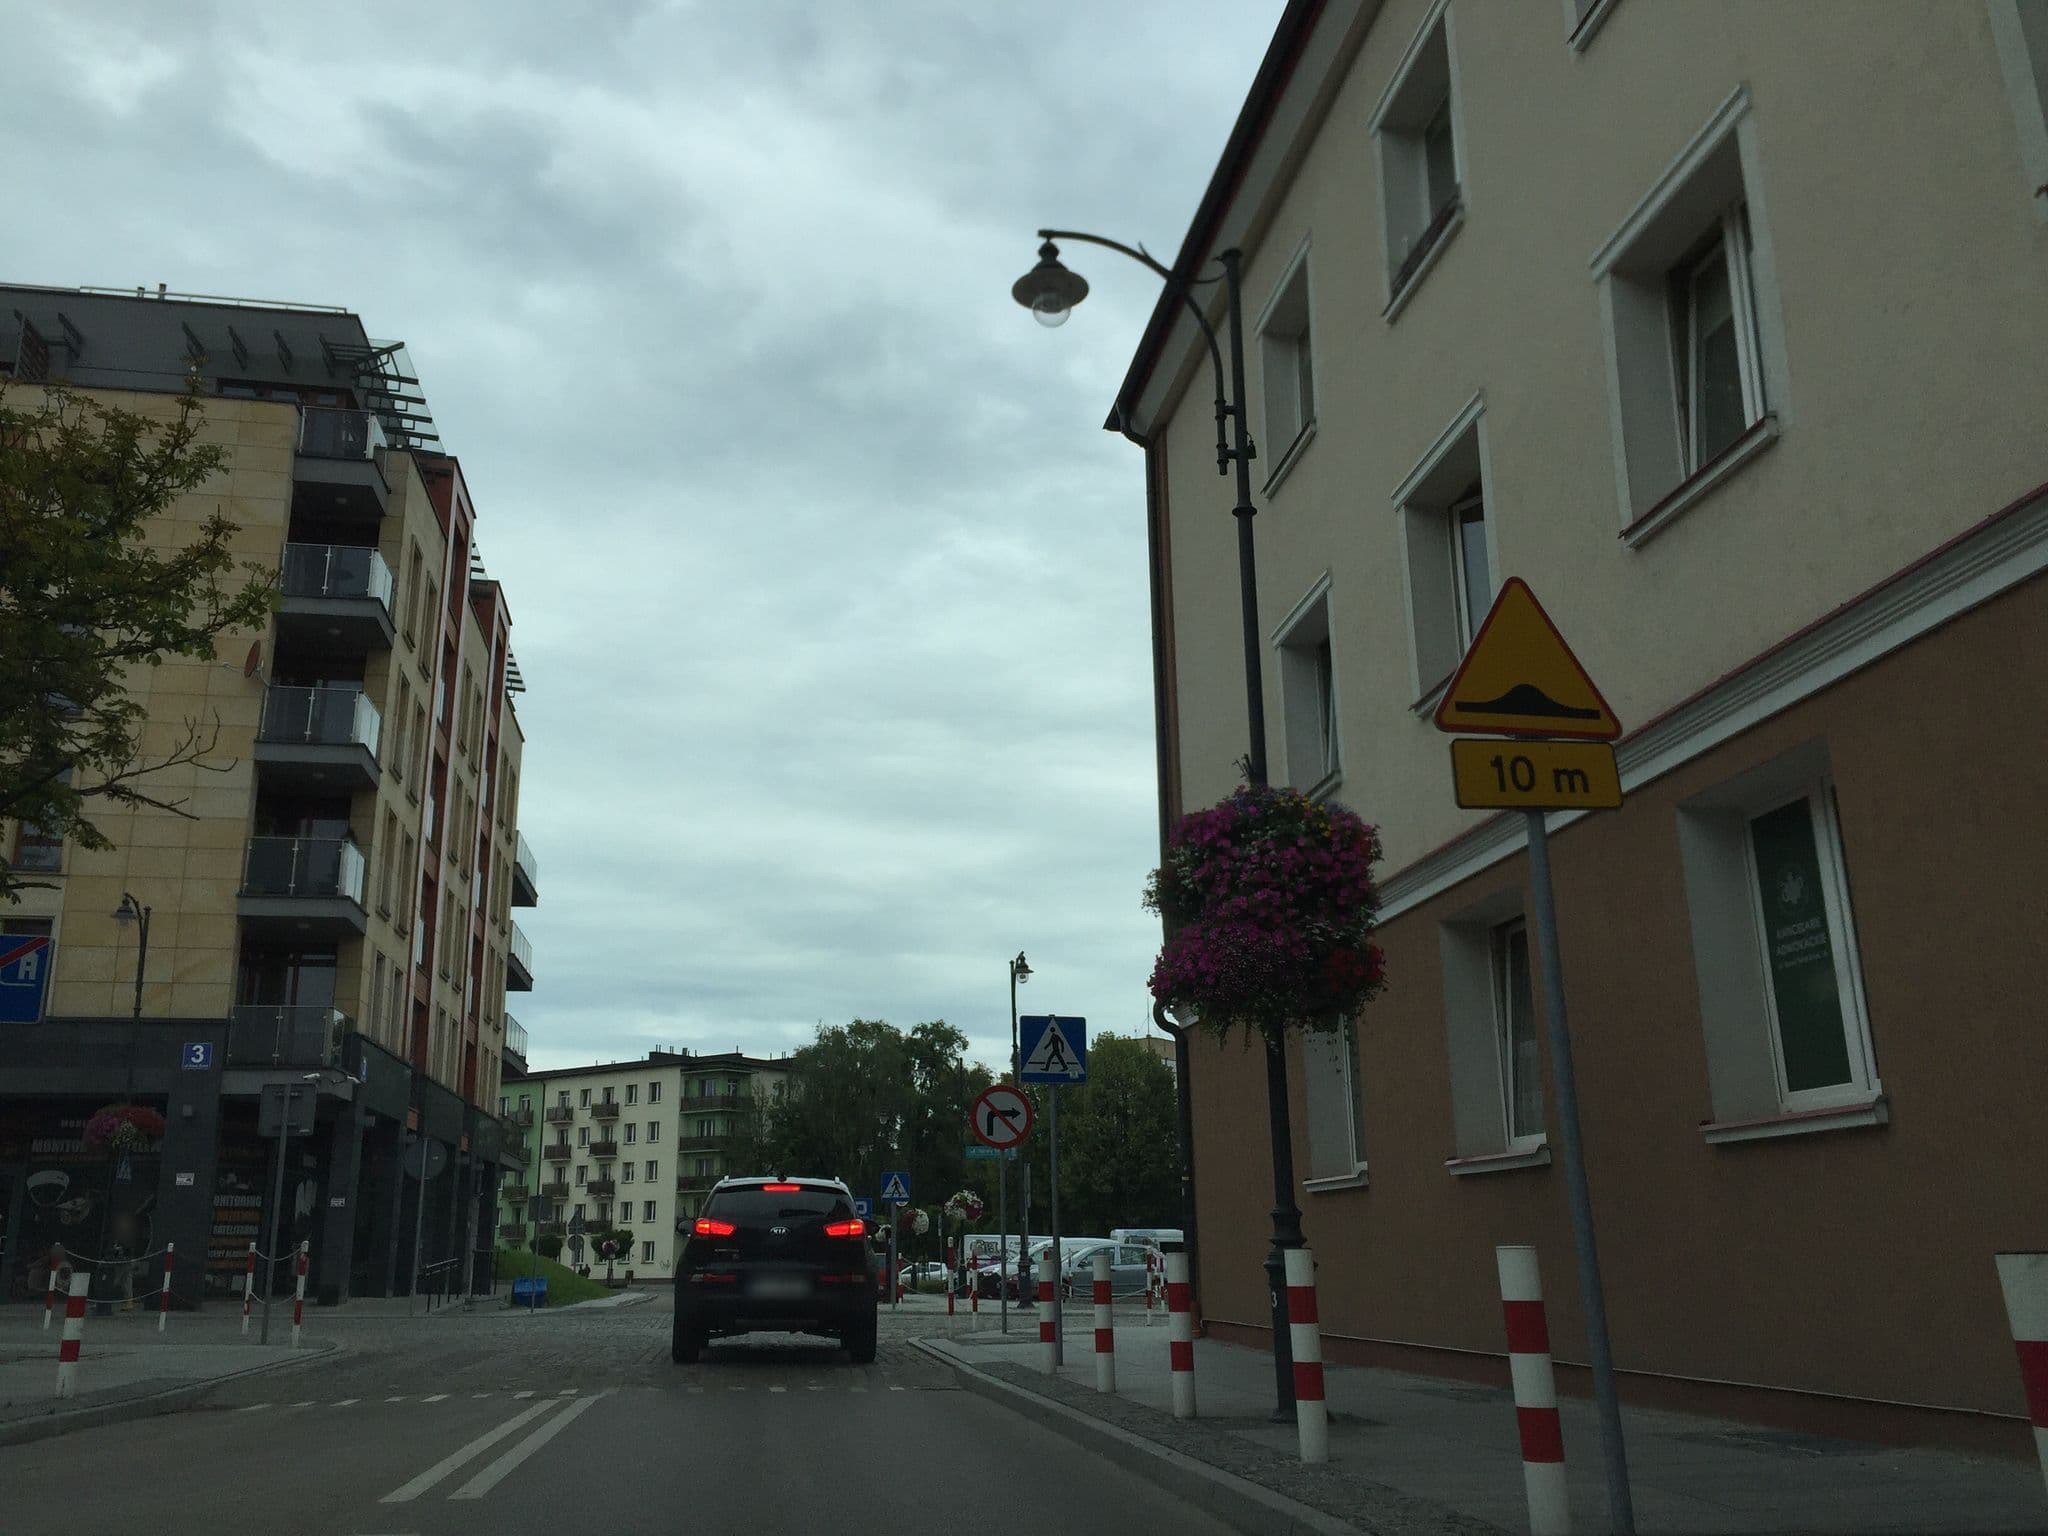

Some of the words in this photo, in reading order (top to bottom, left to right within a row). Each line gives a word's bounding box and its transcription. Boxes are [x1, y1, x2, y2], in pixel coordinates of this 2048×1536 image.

[1490, 754, 1536, 793] 10
[1552, 767, 1590, 794] m
[190, 1044, 205, 1064] 3
[1271, 1290, 1278, 1308] 3
